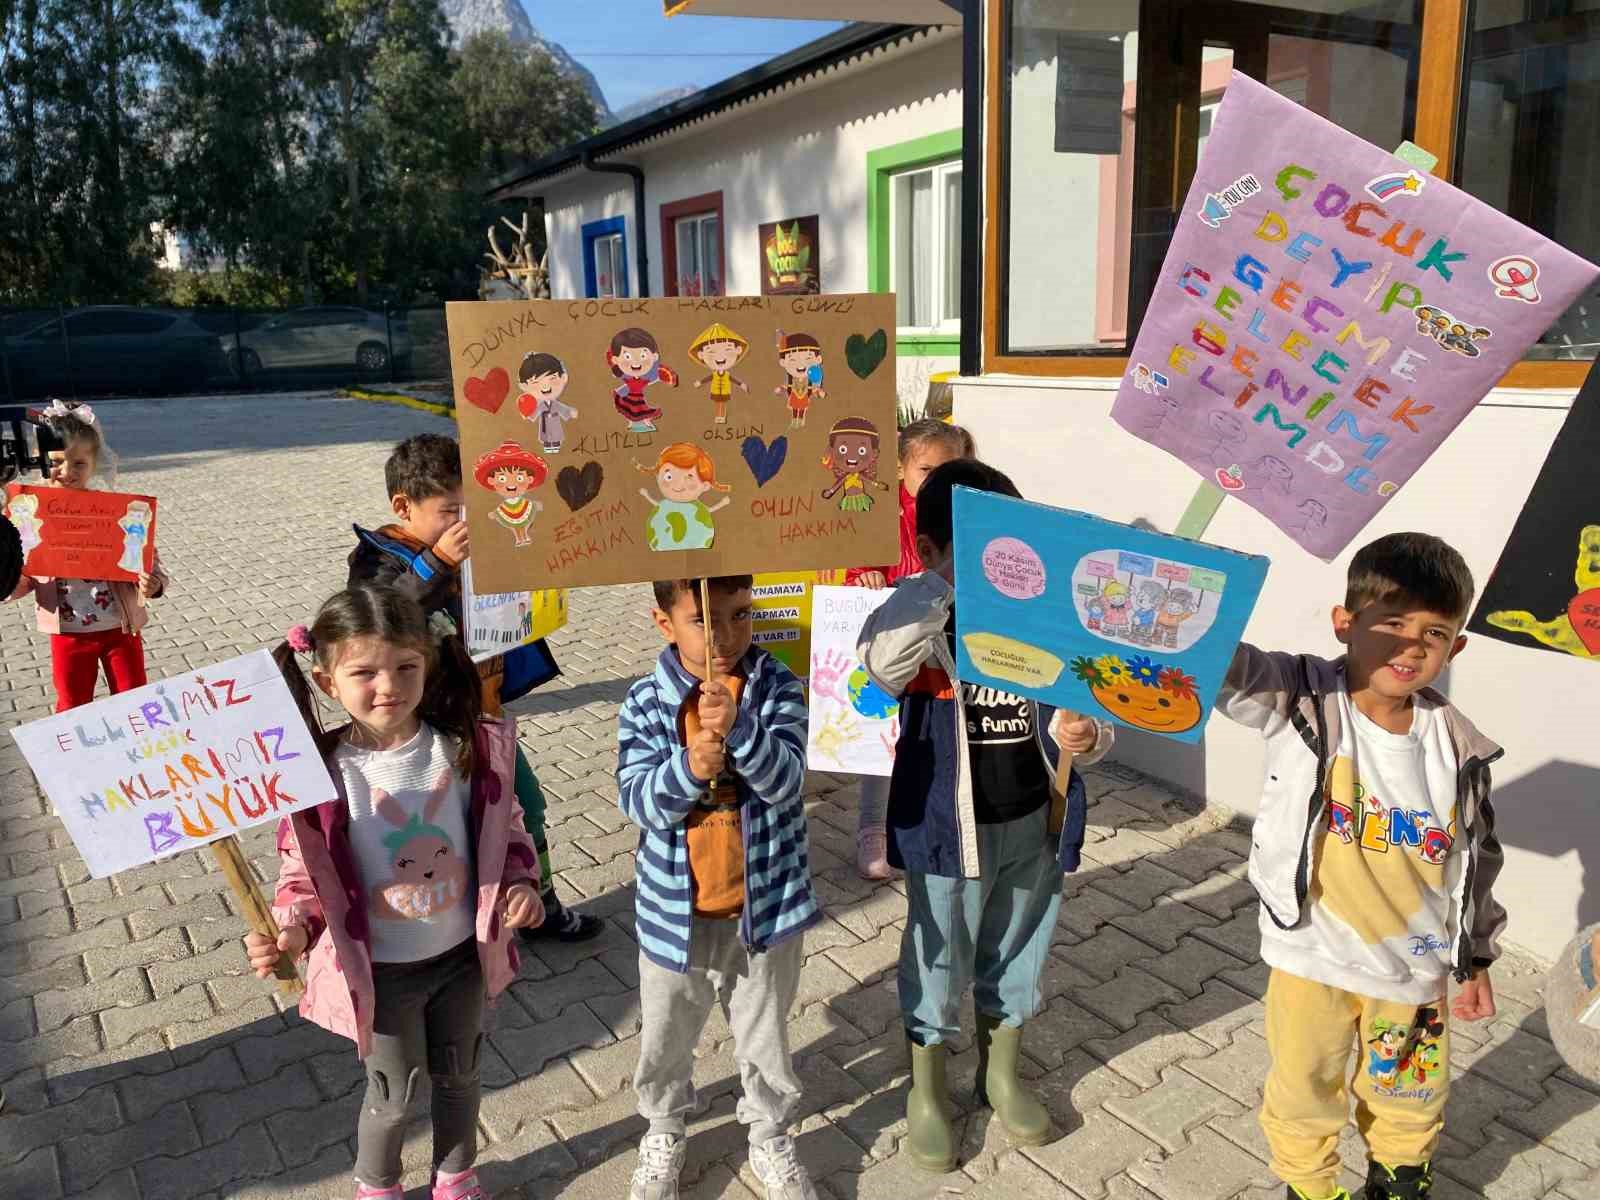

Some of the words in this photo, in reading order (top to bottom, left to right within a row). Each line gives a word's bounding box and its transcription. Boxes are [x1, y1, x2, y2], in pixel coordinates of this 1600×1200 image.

[1223, 187, 1241, 206] YOU
[1239, 174, 1258, 197] CAN!
[1275, 163, 1468, 282] ÇOCUK
[567, 300, 650, 321] ÇOCUK
[677, 297, 772, 313] HAKLARI
[791, 296, 856, 315] GÜNÜ
[1231, 253, 1428, 383] GEÇME
[1176, 261, 1436, 434] GELECEK
[571, 430, 653, 457] KUTLU
[703, 423, 764, 441] OLSUN
[750, 489, 816, 519] OYUN
[779, 516, 858, 545] HAKKIM
[546, 526, 636, 574] HAKKIM
[752, 584, 803, 595] YNAMAYA
[824, 596, 874, 614] BUGÜN
[763, 632, 785, 641] VAR
[786, 631, 797, 640] !!!
[56, 674, 252, 753] ELLERİMİZ
[981, 716, 1031, 734] funny
[143, 770, 299, 856] BÜYÜK
